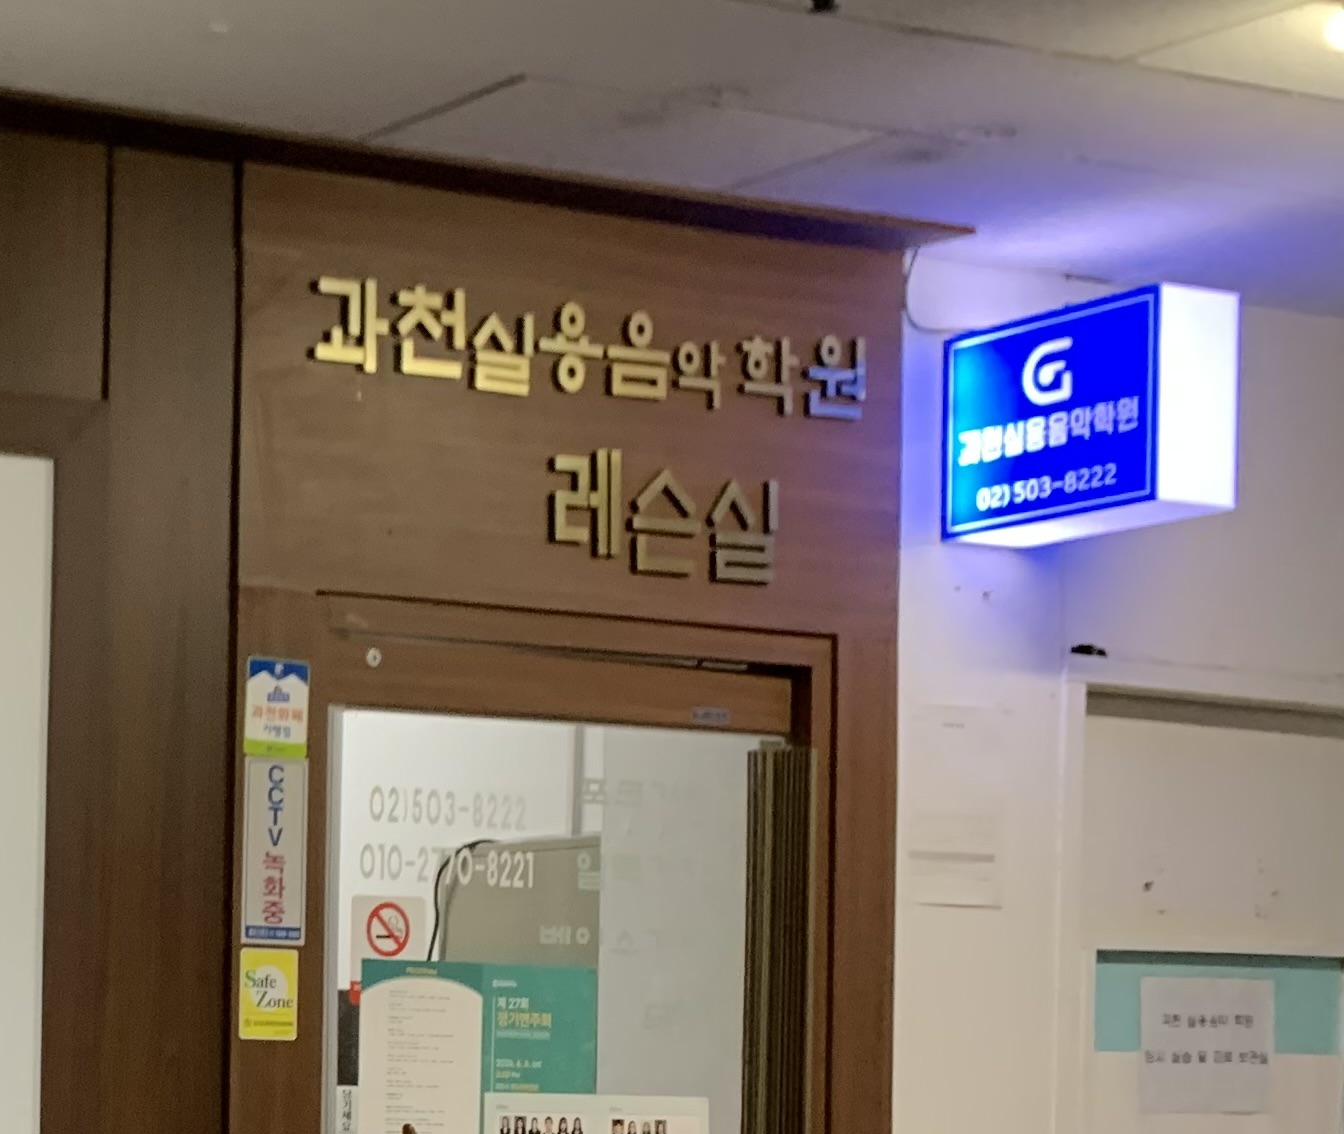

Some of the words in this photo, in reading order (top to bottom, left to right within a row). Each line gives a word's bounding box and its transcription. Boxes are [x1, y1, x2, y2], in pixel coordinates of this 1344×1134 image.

[957, 395, 1140, 467] 과천실용음악학원
[548, 448, 779, 585] 레슨실
[267, 765, 285, 847] CCTV
[369, 785, 526, 830] 02)503-8222
[261, 851, 287, 925] 녹화중
[244, 968, 278, 989] Safe
[256, 990, 294, 1009] Zone
